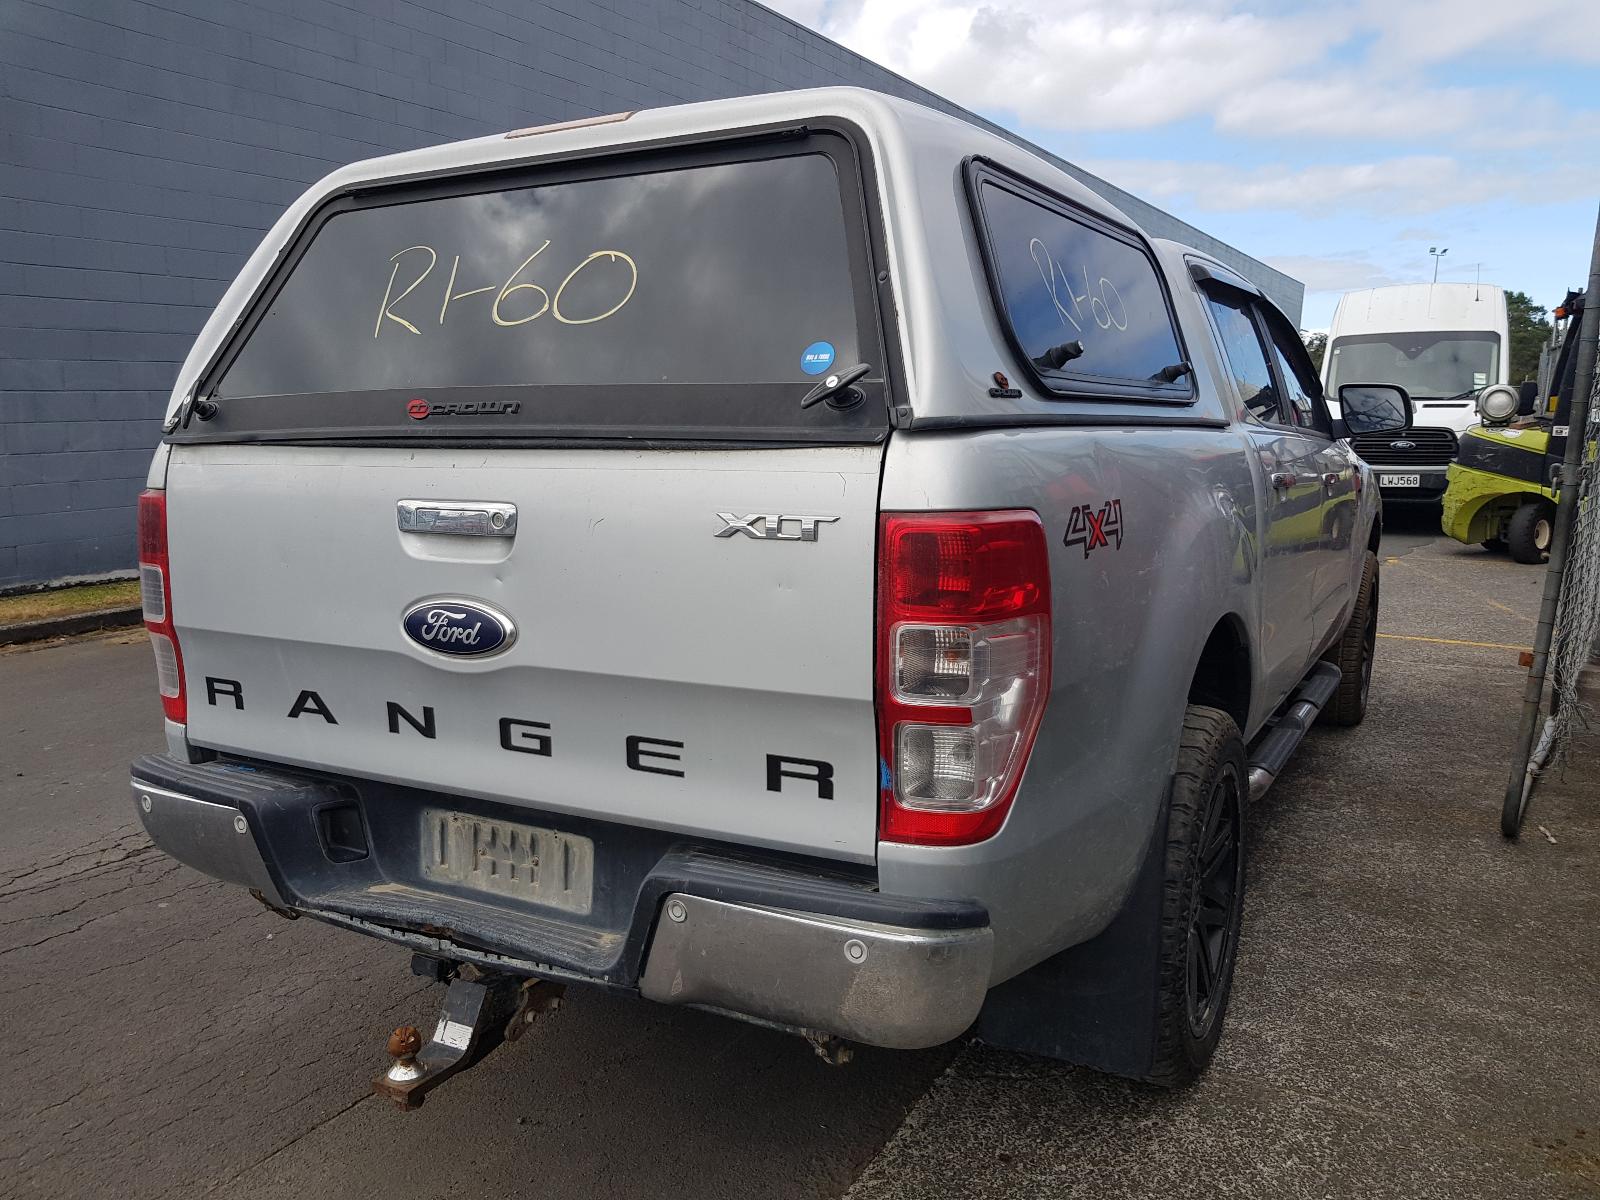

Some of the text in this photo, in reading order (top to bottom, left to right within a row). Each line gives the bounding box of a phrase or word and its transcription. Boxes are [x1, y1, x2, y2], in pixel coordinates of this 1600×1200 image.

[430, 400, 521, 415] CROWN
[1381, 476, 1418, 486] LWJ568
[713, 512, 841, 542] XLT
[421, 609, 482, 645] Ford
[205, 675, 834, 800] RANGER
